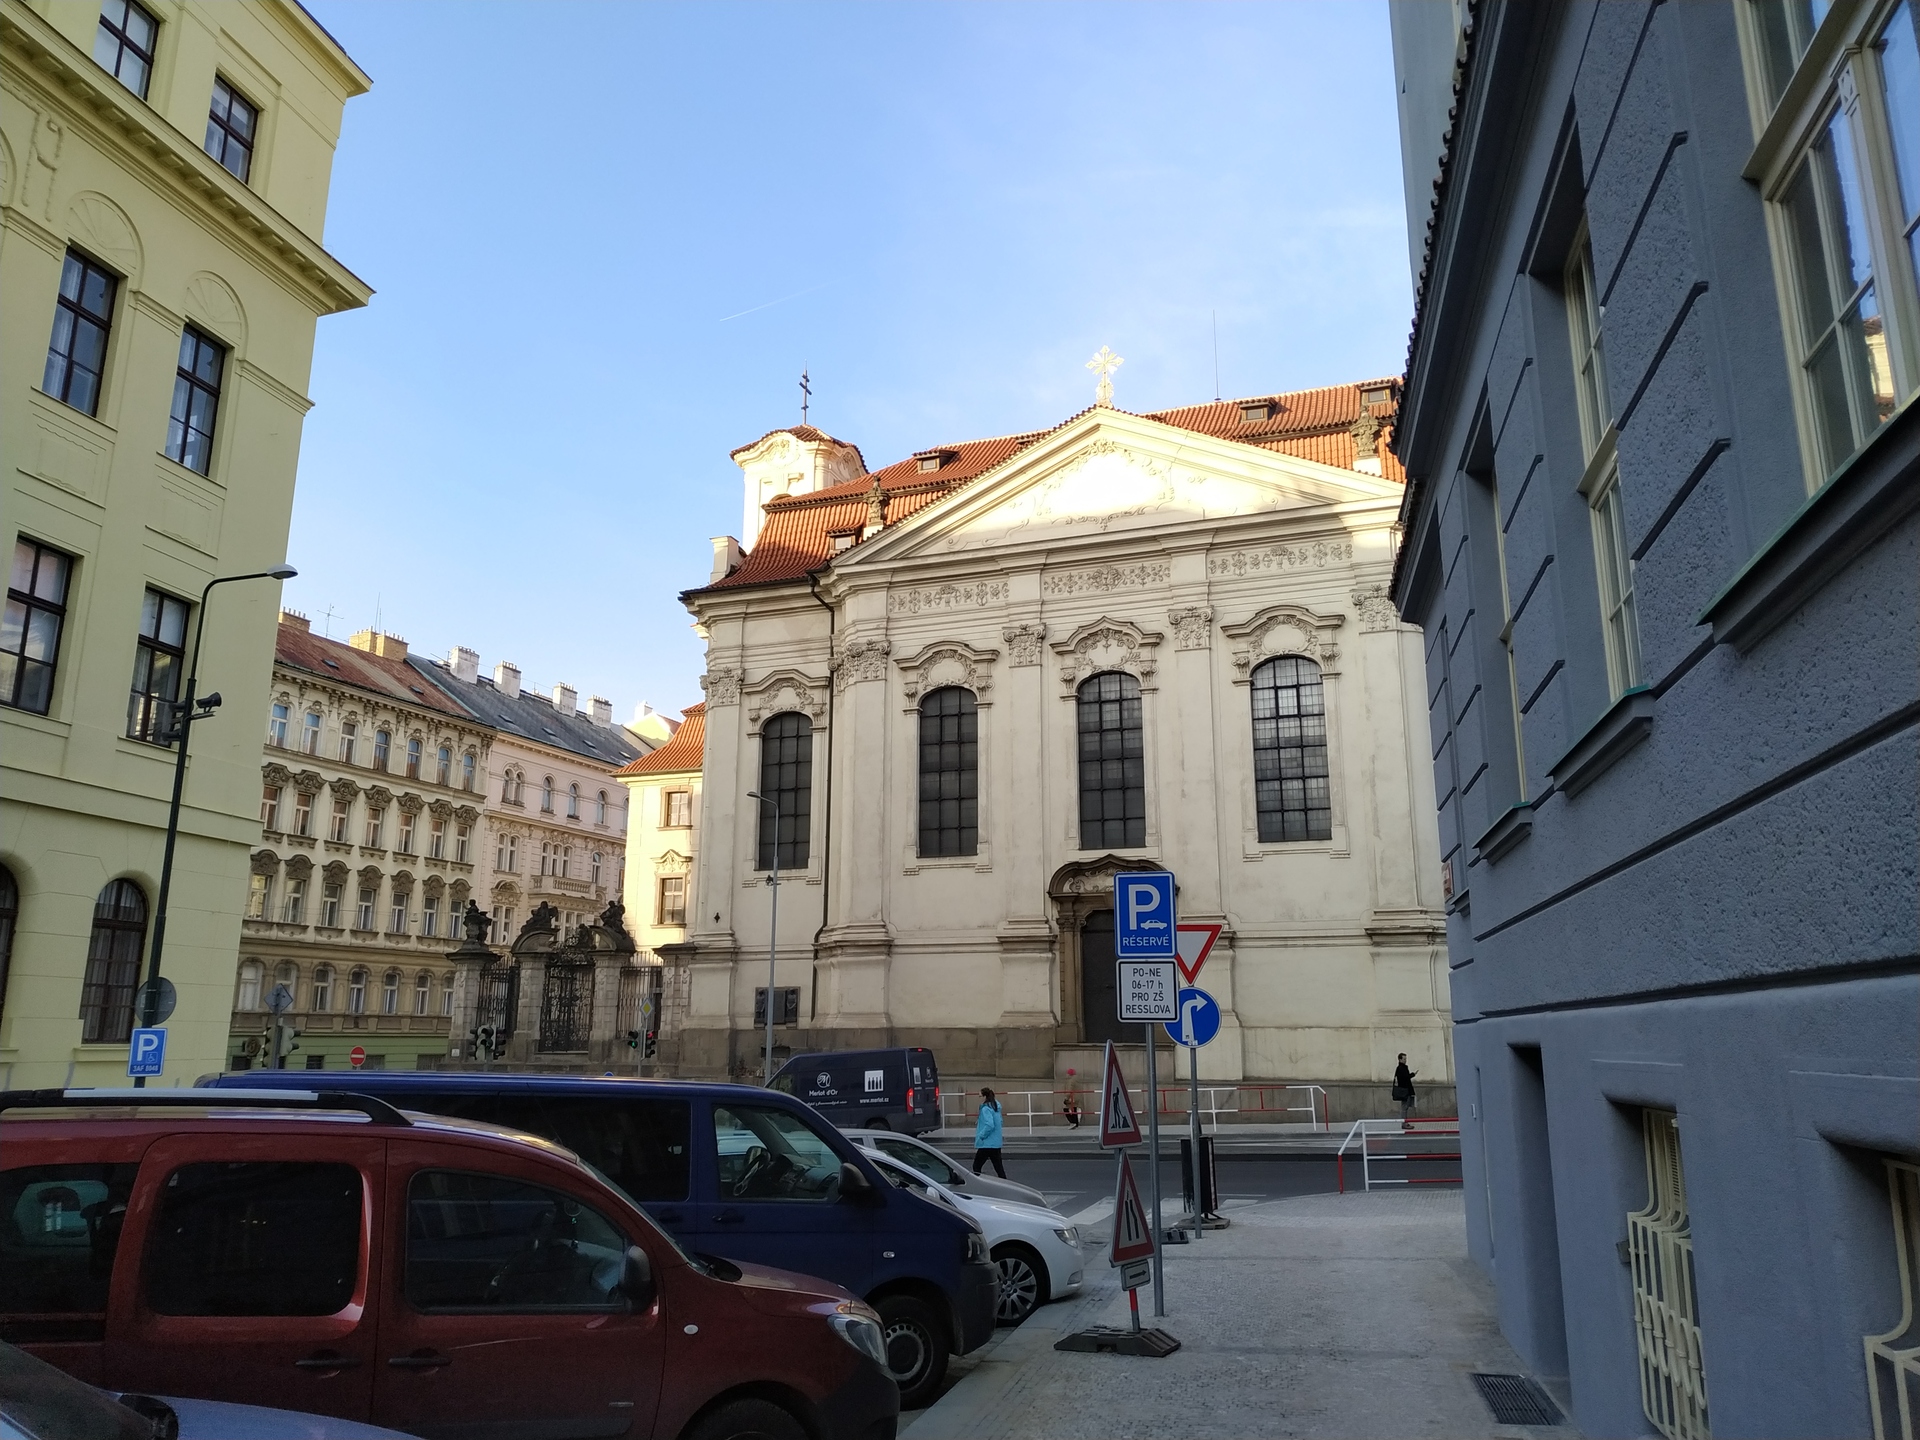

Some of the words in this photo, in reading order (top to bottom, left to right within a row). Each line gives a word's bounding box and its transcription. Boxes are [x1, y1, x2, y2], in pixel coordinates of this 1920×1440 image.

[1128, 884, 1161, 931] P
[1122, 934, 1170, 947] RÉSERVÉ
[1132, 968, 1162, 977] PO-NE
[1131, 980, 1155, 989] 06-17
[1157, 980, 1164, 989] h
[1131, 992, 1150, 1002] PRO
[1152, 990, 1164, 1002] ZŠ
[1125, 1004, 1171, 1014] RESSLOVA
[136, 1034, 158, 1061] P
